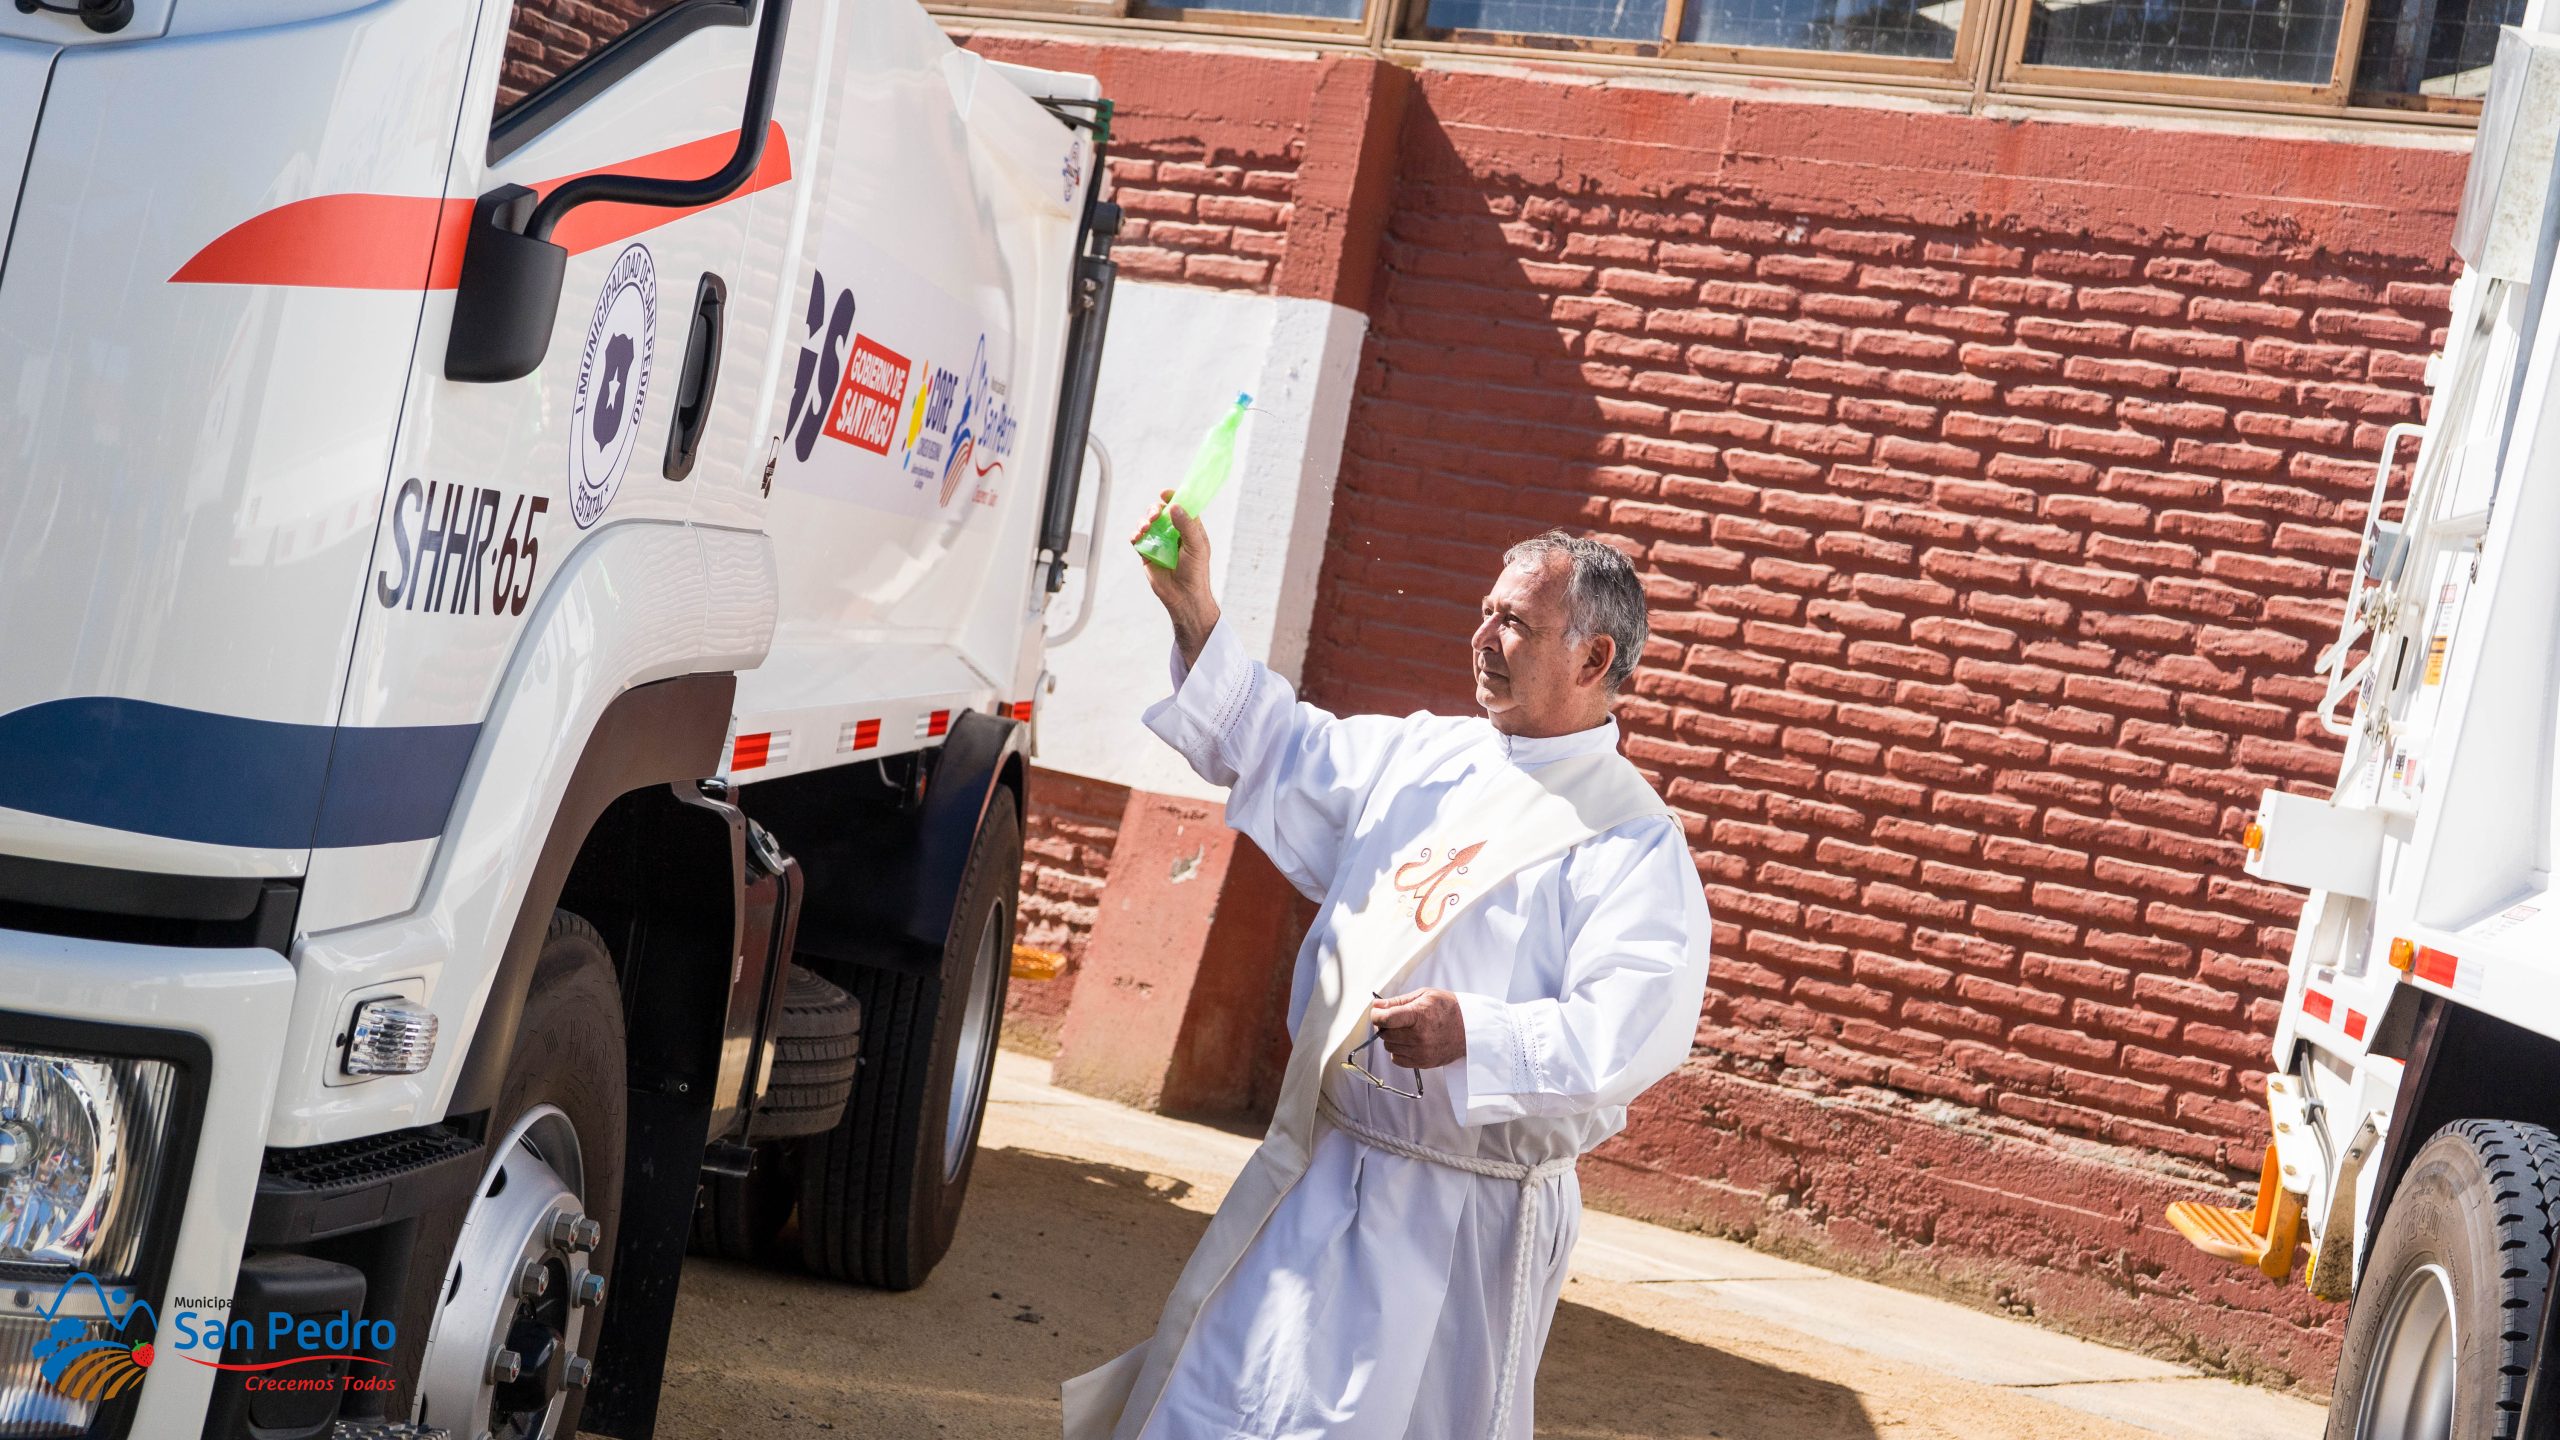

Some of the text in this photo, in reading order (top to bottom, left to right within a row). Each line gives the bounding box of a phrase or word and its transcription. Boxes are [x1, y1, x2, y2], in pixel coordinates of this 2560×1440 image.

[640, 257, 650, 292] DE
[645, 281, 654, 333] SAN
[633, 336, 653, 425] PEDRO
[850, 347, 907, 401] GOBIERNO DE
[925, 366, 959, 435] CORE
[836, 388, 896, 448] SANTIAGO
[576, 484, 604, 523] ESTATAL
